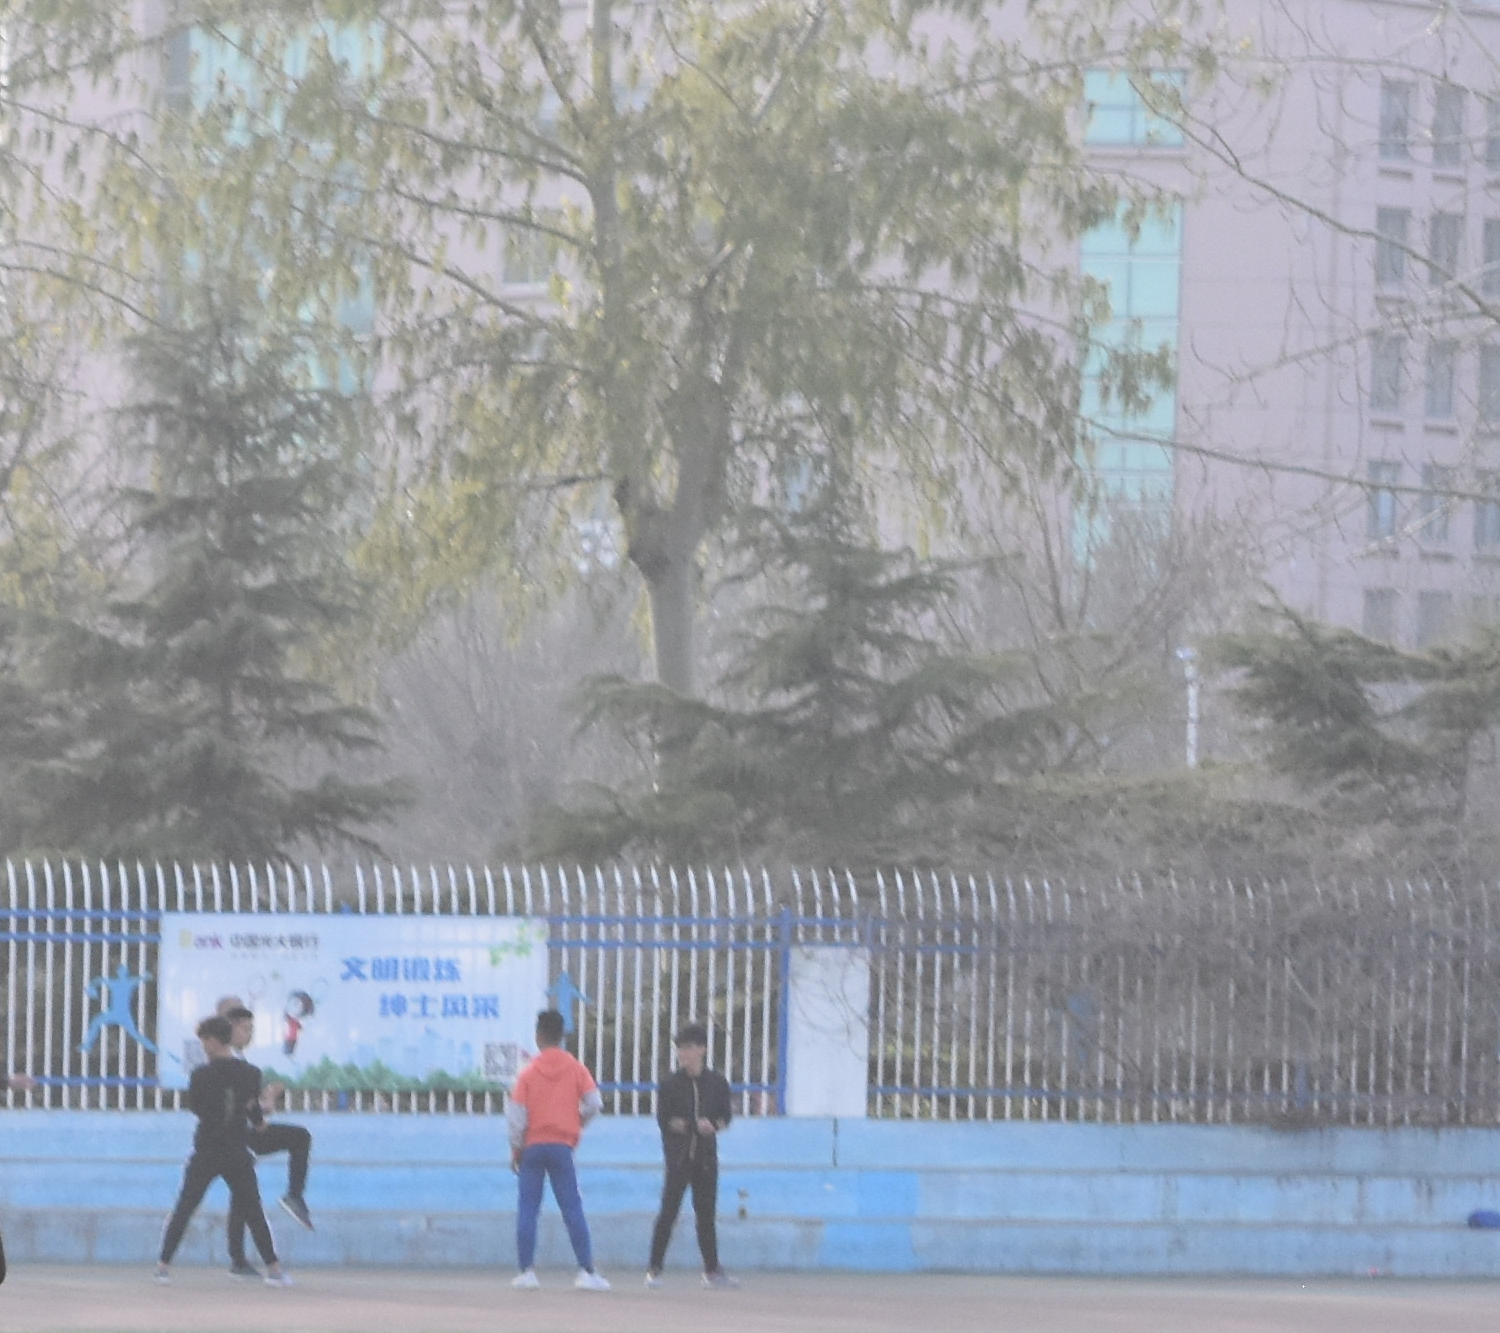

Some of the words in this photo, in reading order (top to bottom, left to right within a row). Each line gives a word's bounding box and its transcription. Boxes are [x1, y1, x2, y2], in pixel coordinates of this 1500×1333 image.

[340, 956, 462, 981] 文明锻炼
[379, 993, 500, 1018] 绅士风采
